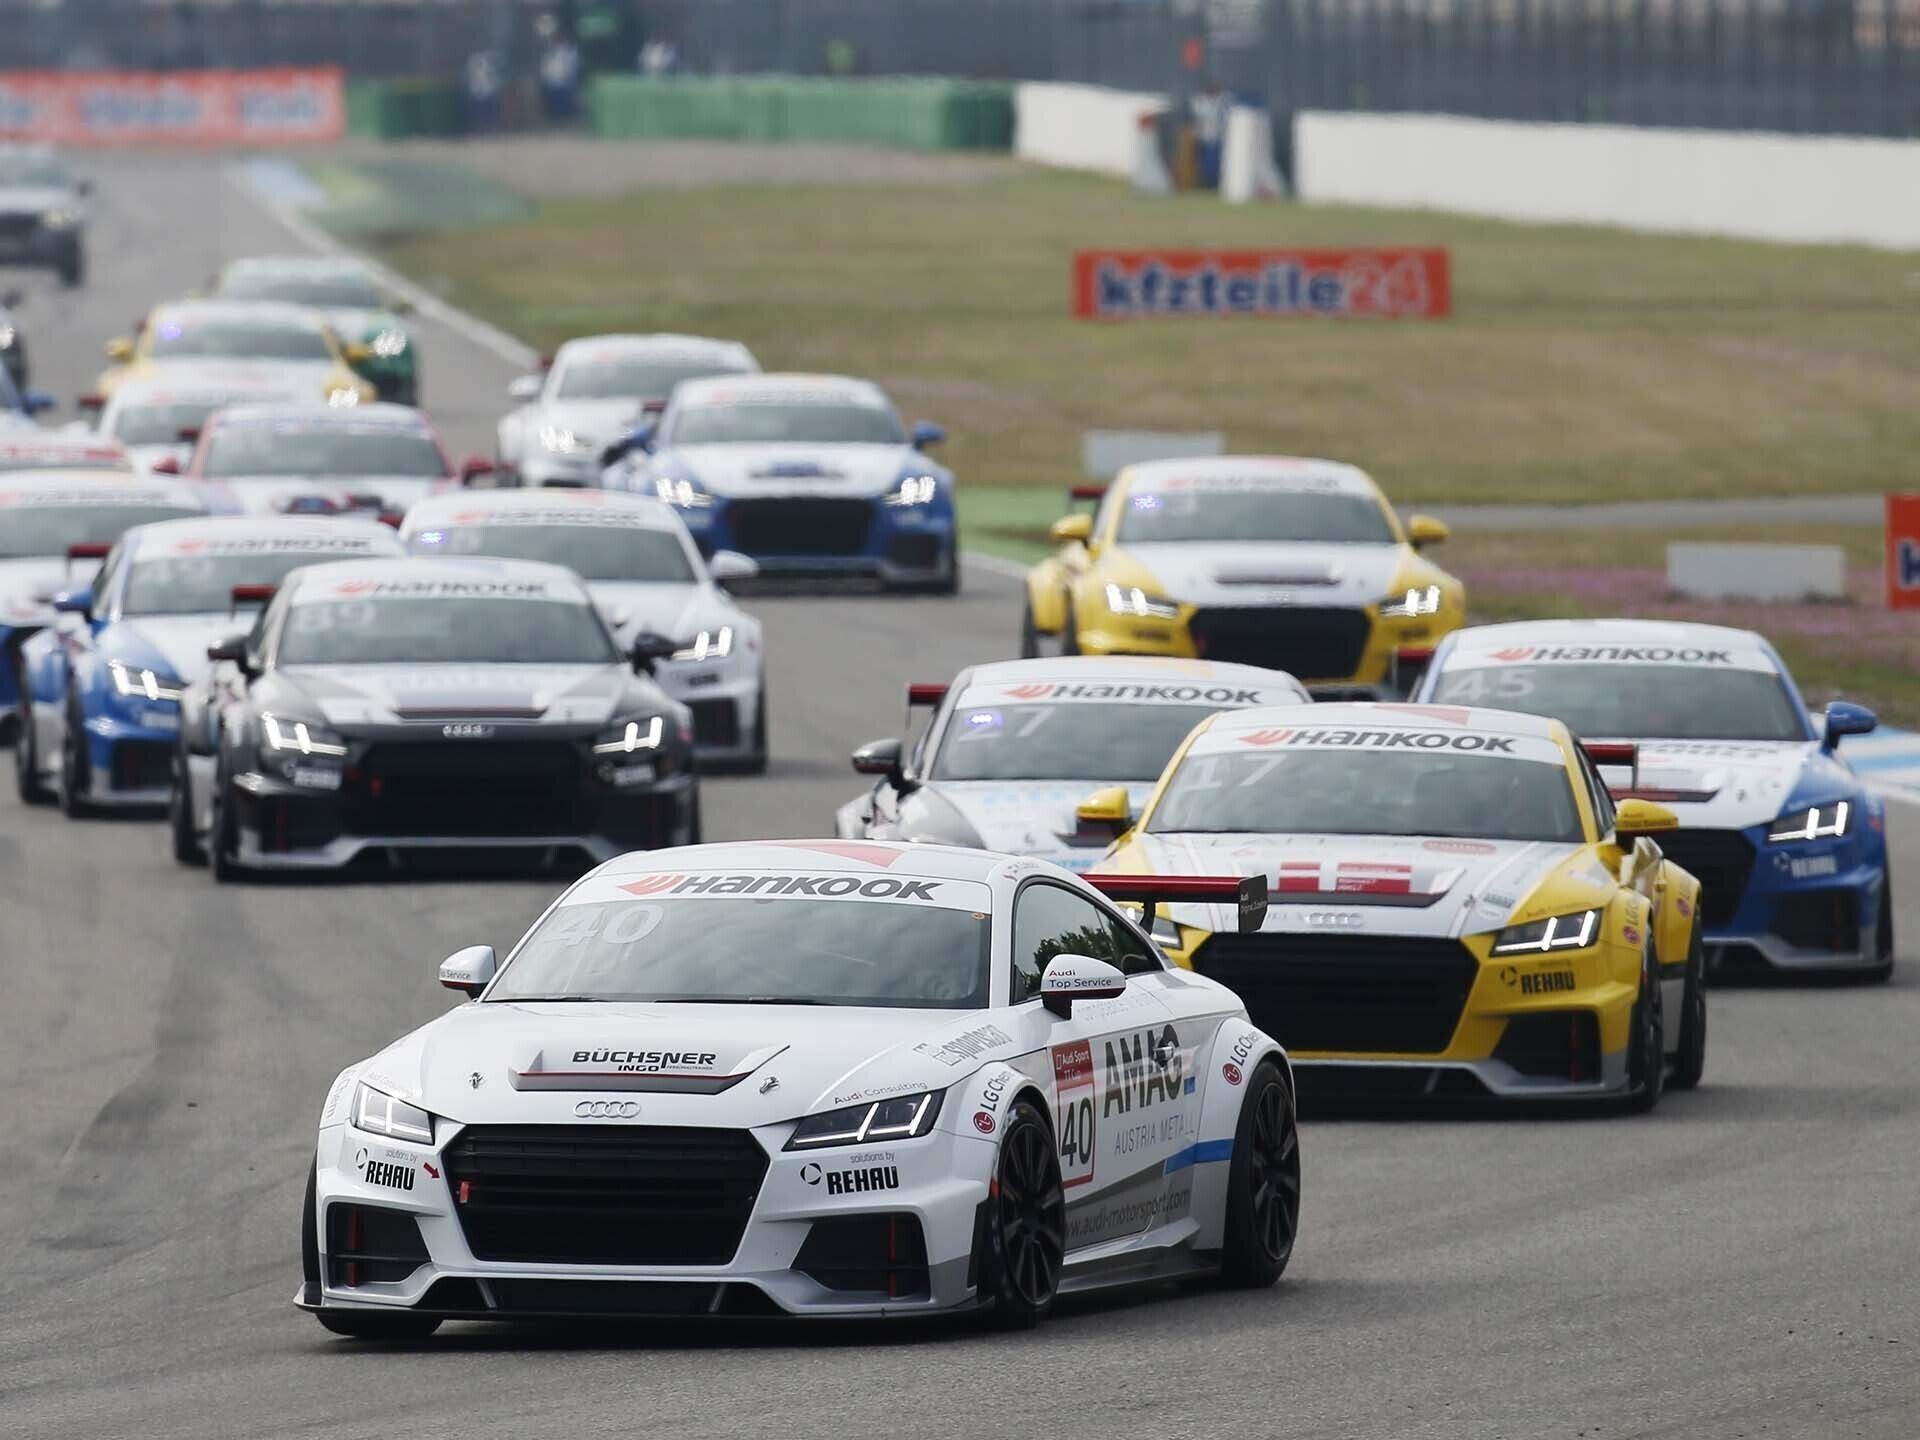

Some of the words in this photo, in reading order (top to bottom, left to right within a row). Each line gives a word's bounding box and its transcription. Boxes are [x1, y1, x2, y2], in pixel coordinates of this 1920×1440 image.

[1098, 258, 1428, 314] kfzteile24
[1443, 668, 1537, 701] 45
[545, 904, 664, 948] 40
[1049, 969, 1076, 977] Audi
[1049, 979, 1071, 989] Top
[1074, 978, 1112, 988] Service
[1520, 970, 1576, 995] REHAU
[572, 1047, 717, 1069] BÜCHSNER
[617, 1064, 660, 1072] INGO
[834, 1092, 863, 1104] Audi
[864, 1080, 929, 1097] Consulting
[1060, 1097, 1093, 1167] 40
[1114, 1119, 1156, 1156] AUSTRIA
[1160, 1111, 1195, 1144] METALL
[850, 1152, 884, 1164] solutions
[885, 1151, 895, 1162] by
[365, 1160, 416, 1191] REHAU
[826, 1166, 899, 1195] REHAU
